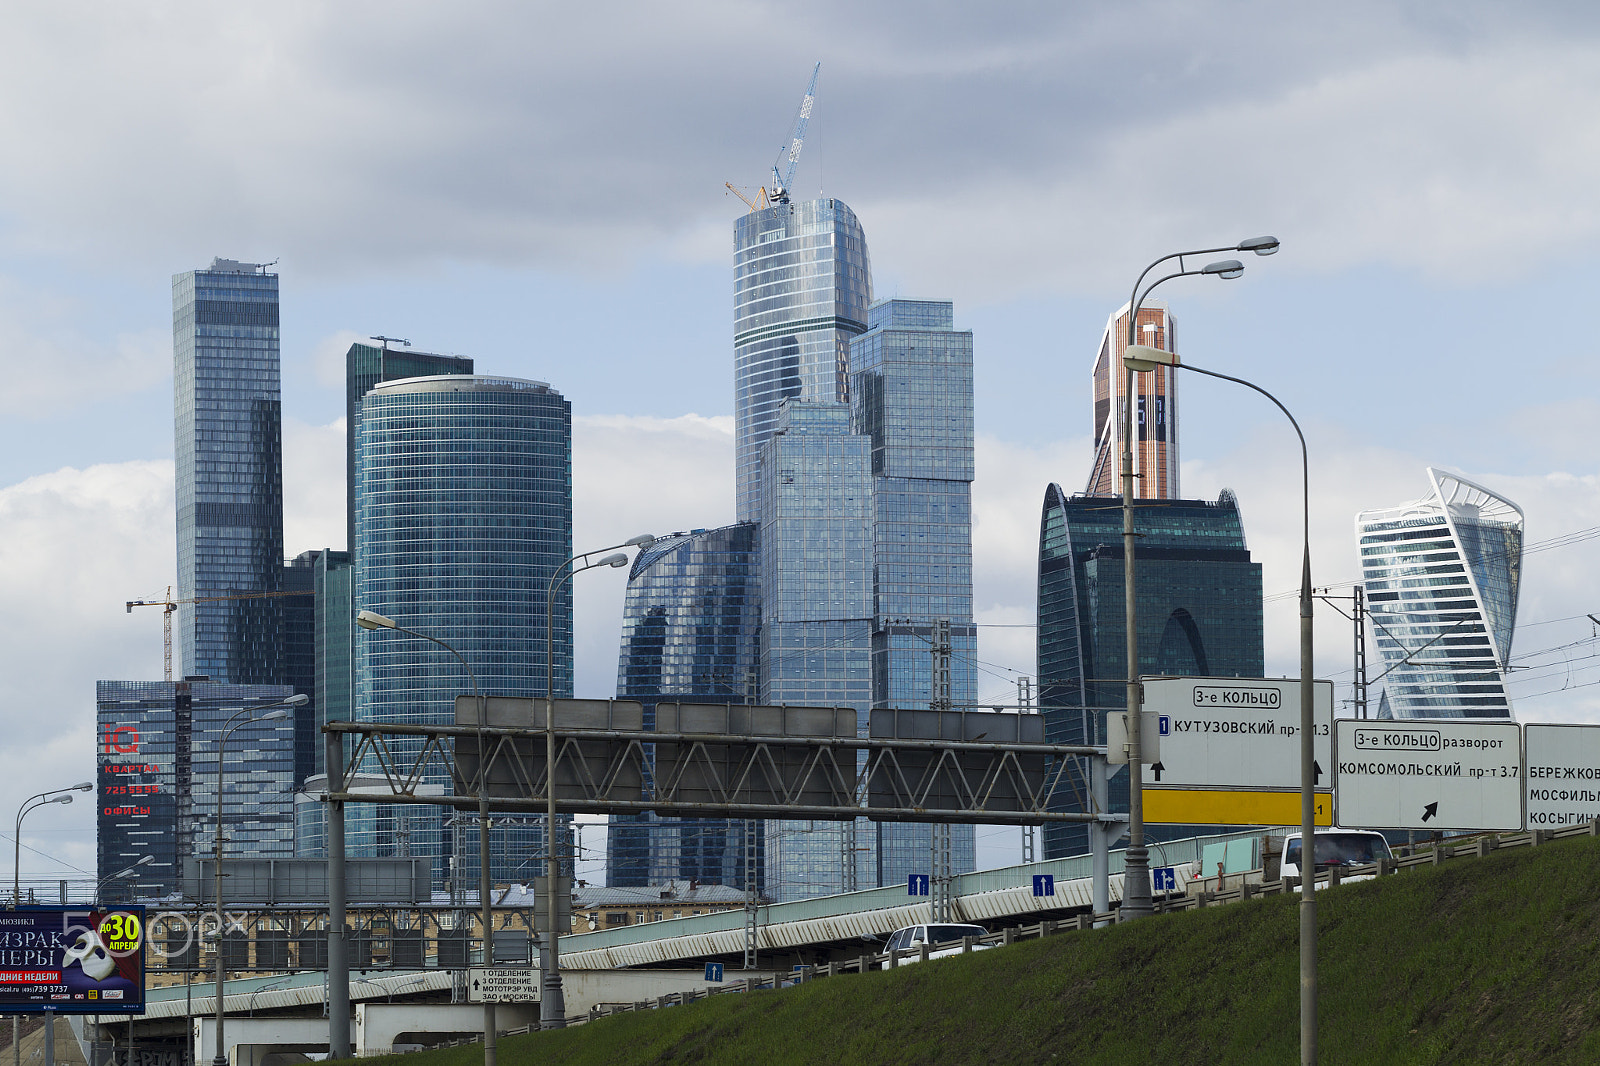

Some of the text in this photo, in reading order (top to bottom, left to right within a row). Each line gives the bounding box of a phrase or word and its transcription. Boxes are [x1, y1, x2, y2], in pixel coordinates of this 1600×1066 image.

[1196, 690, 1279, 706] 3-е КОЛЬЦО
[1174, 719, 1275, 734] КУТУЗОВСКИЙ
[1357, 733, 1504, 751] 3-е КОЛЬЦО разворот
[105, 764, 160, 773] КВАРТАЛ
[1339, 761, 1519, 780] КОМСОМОЛЬСКИЙ пр-т 3.7
[105, 785, 159, 795] 725 55 55
[1529, 788, 1600, 802] МОСФИЛЬ
[104, 806, 151, 816] ОФИСЫ
[1529, 812, 1600, 825] КОСЫГИН
[110, 914, 139, 940] 30
[109, 941, 139, 950] АПРЕЛЯ
[24, 972, 58, 982] НЕДЕЛИ
[49, 985, 68, 993] 3737
